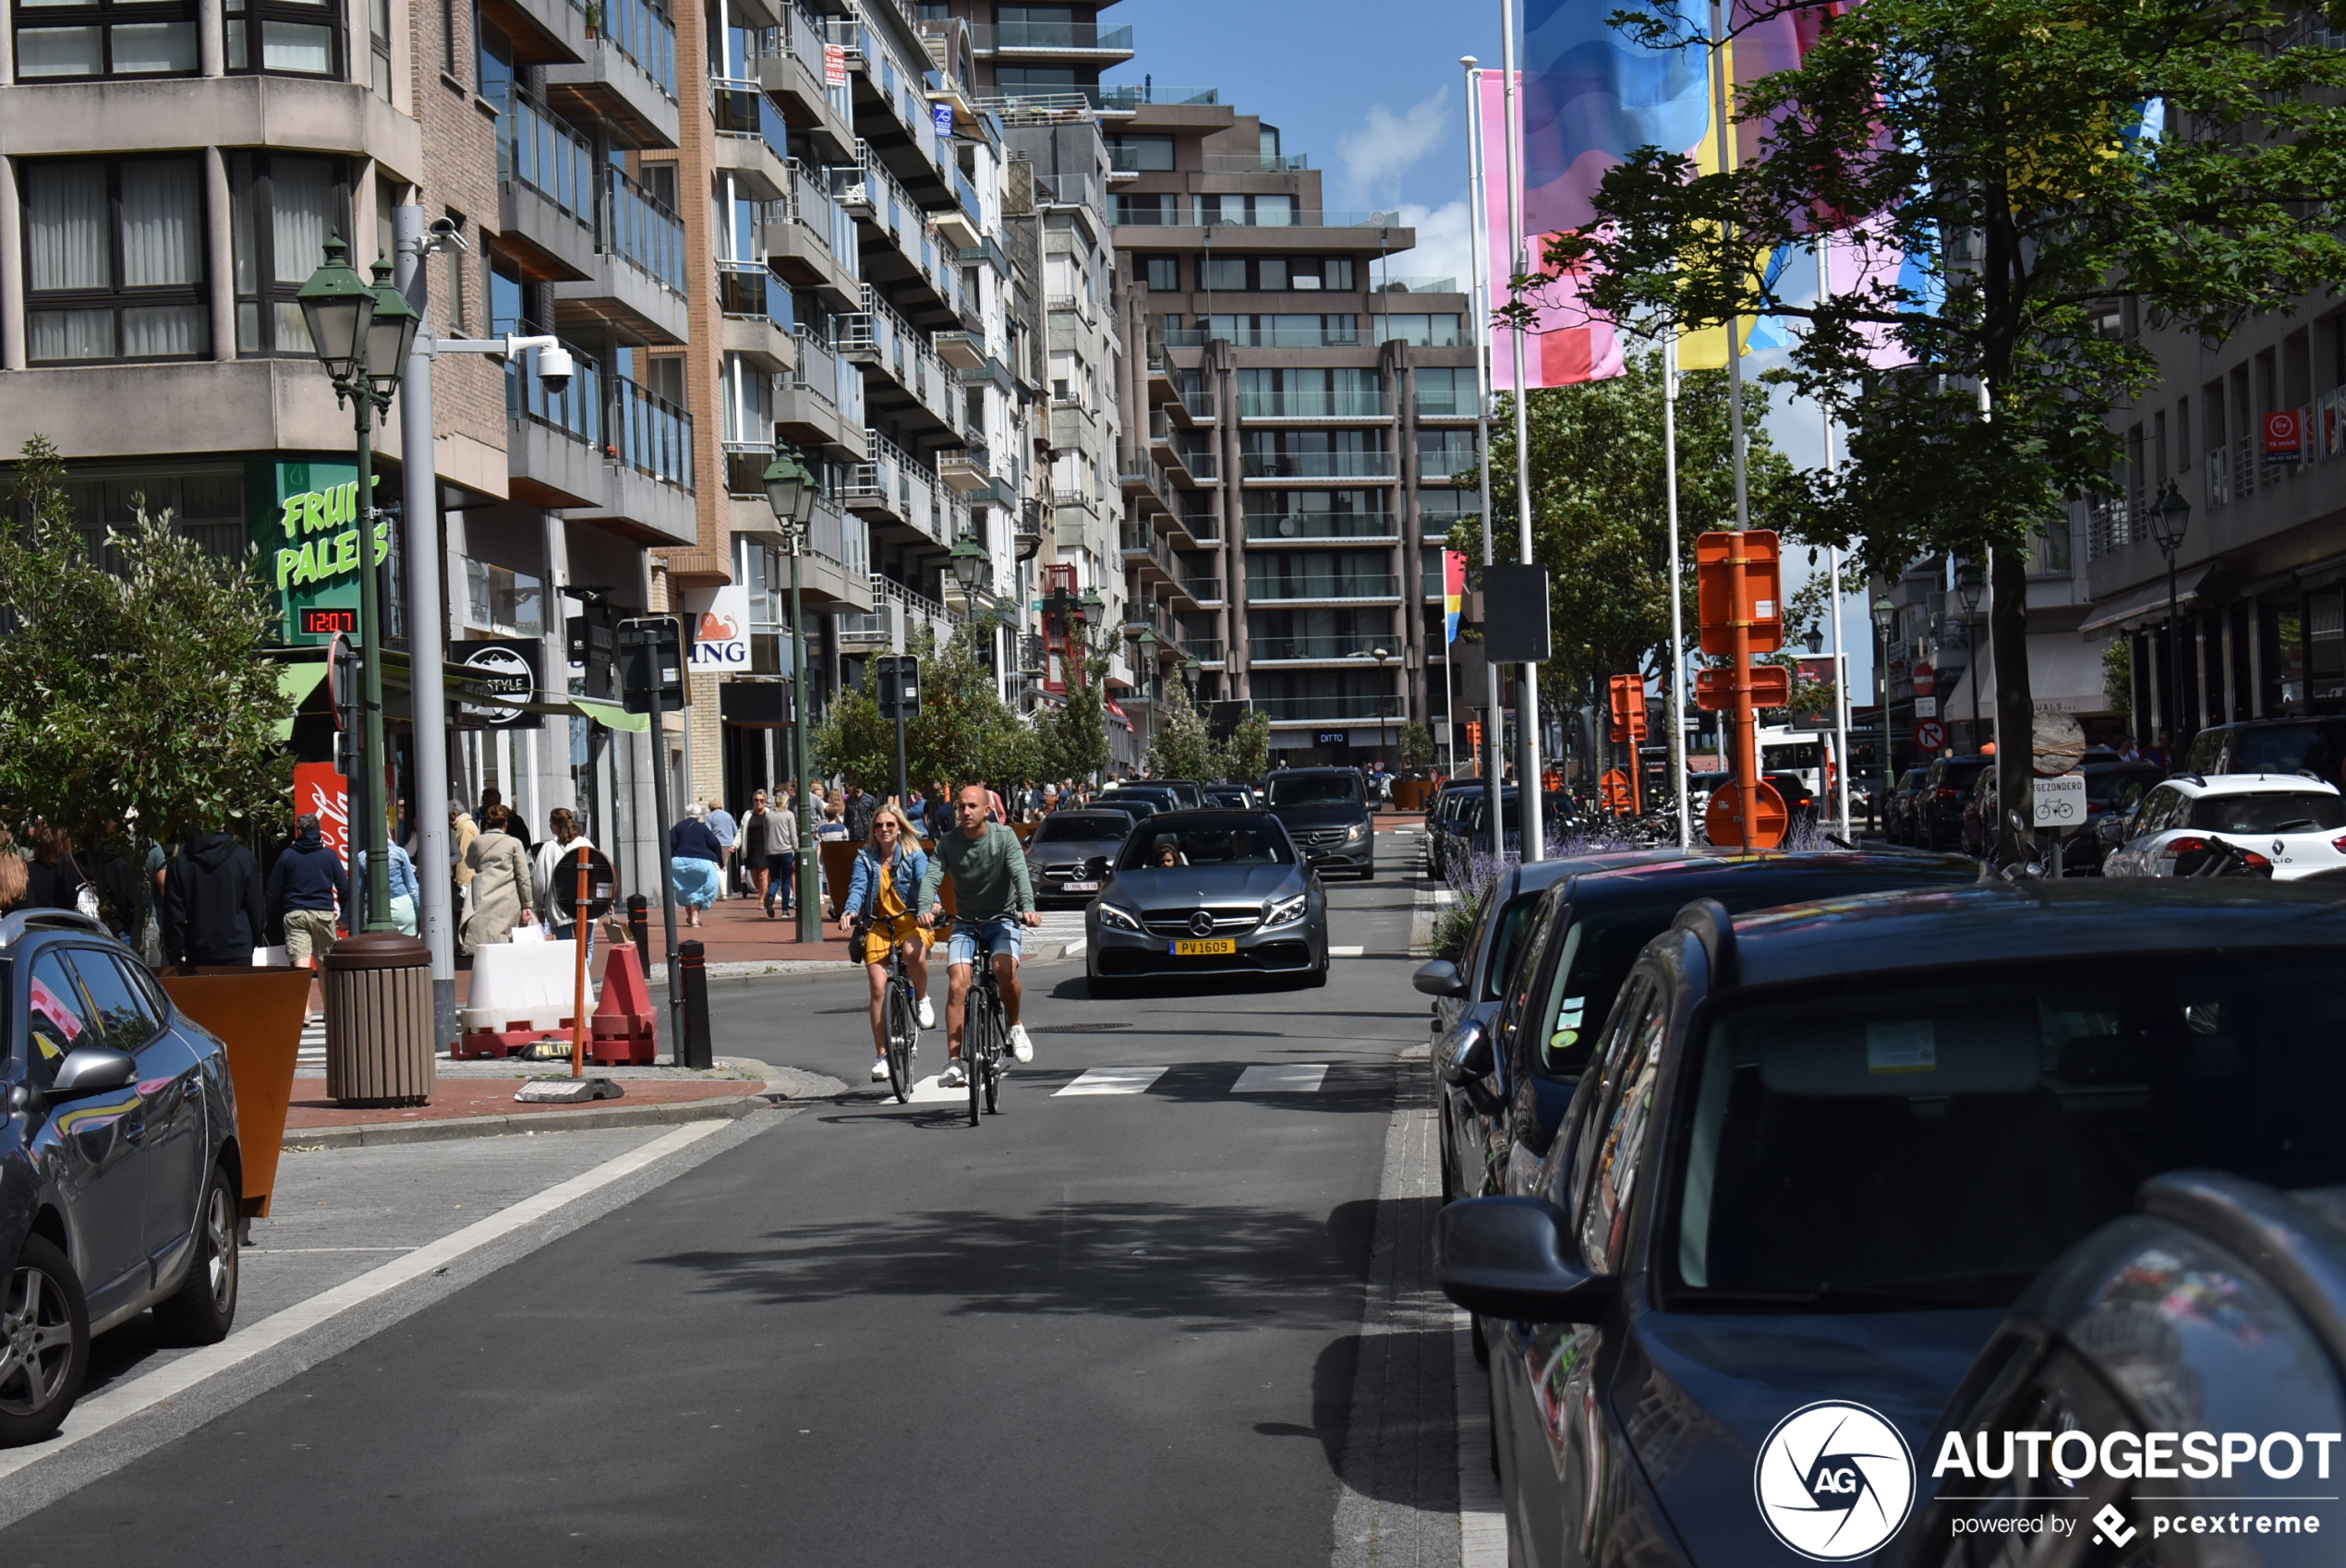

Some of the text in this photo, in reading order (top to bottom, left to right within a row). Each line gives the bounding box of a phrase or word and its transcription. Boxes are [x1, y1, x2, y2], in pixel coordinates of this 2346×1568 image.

[277, 522, 388, 591] PALES
[309, 613, 351, 632] 12:07
[689, 641, 745, 664] ING
[1321, 733, 1344, 742] DITTO
